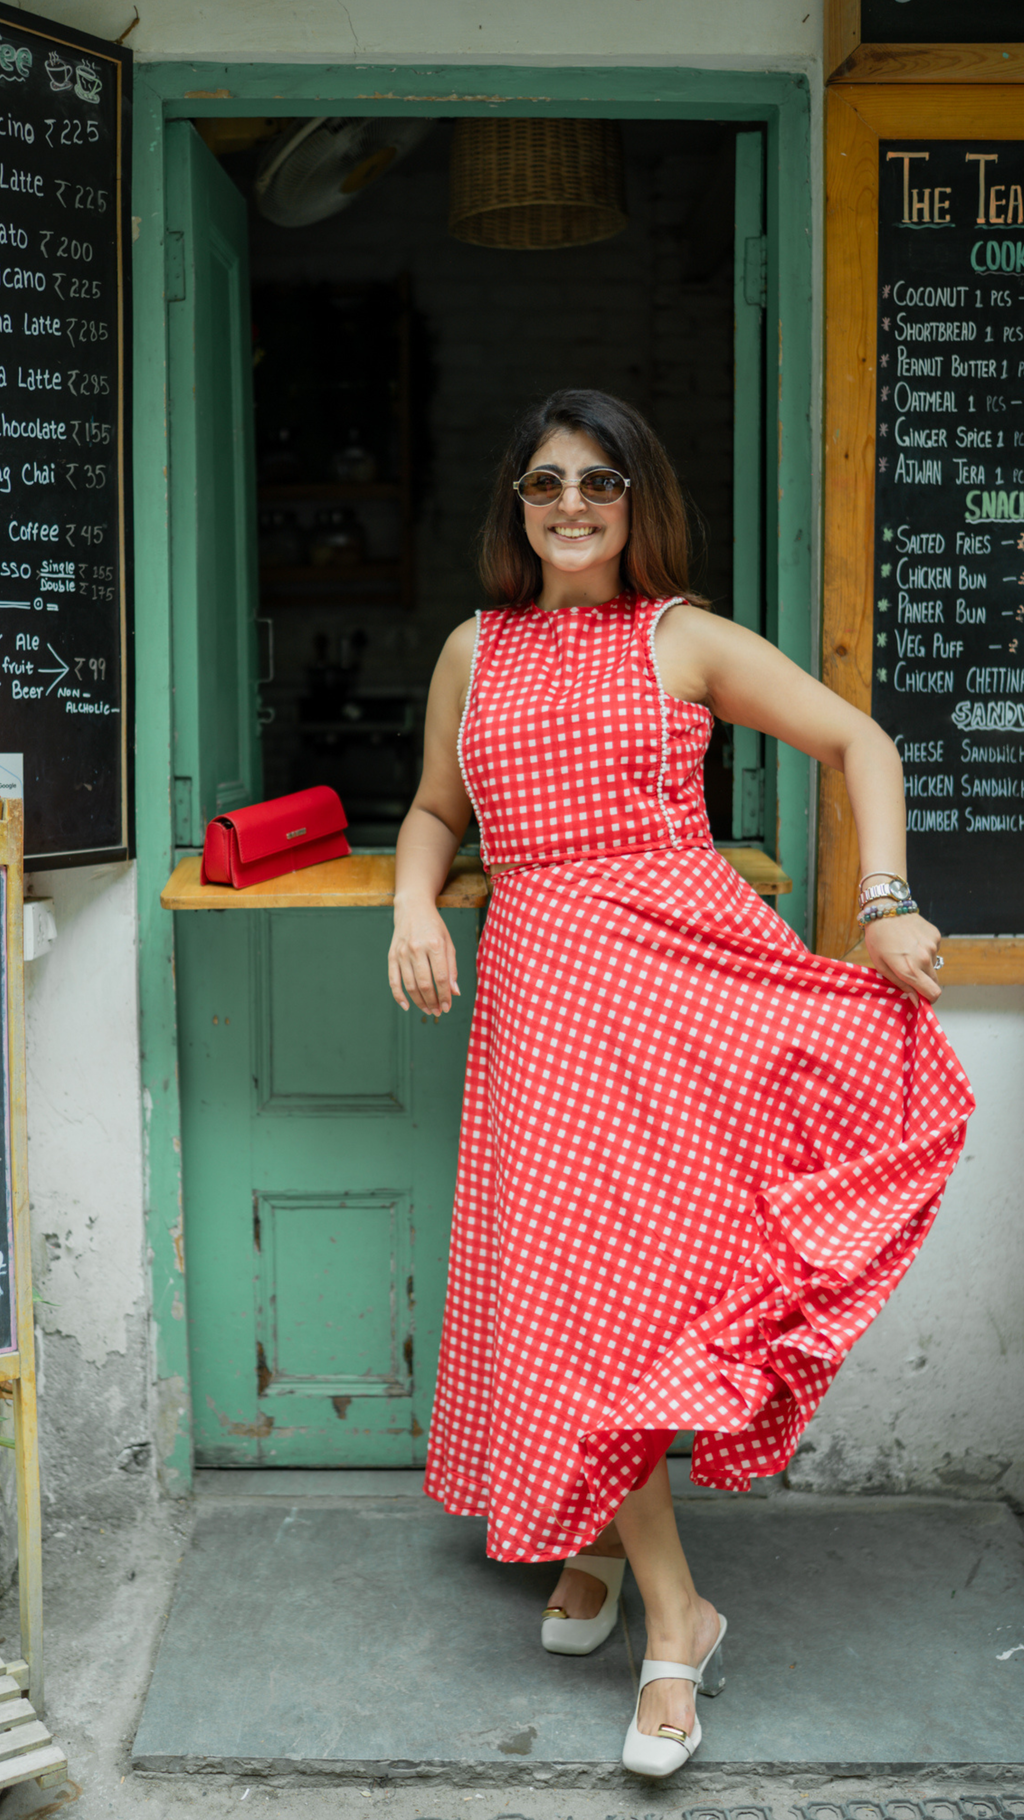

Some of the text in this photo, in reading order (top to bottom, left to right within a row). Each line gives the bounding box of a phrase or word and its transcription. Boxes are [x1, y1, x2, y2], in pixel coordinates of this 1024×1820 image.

[0, 163, 44, 196] Latte
[886, 151, 1024, 224] THE TEA
[893, 280, 1012, 308] COCONUT 1 PCS
[24, 313, 62, 336] Latte
[895, 312, 1024, 343] SHORTBREAD 1 PCS
[897, 345, 944, 377] PEANUT
[951, 354, 997, 378] BUTTER
[1000, 359, 1008, 379] 1
[18, 367, 62, 391] Latte
[894, 381, 1006, 413] OATMEAL 1 PCS
[0, 413, 67, 440] hocolate
[895, 416, 948, 448] GINGER
[955, 426, 992, 448] SPICE
[997, 430, 1005, 448] 1
[21, 462, 55, 485] Chai
[894, 452, 942, 485] AJWAN
[952, 458, 985, 485] JERA
[995, 466, 1004, 485] 1
[9, 520, 59, 542] Coffee
[895, 525, 991, 555] SALTED FRIES
[41, 560, 75, 575] Single
[896, 557, 986, 590] CHICKEN BUN
[40, 577, 76, 593] Double
[897, 591, 986, 624] PANEER BUN
[16, 633, 40, 651] Ale
[894, 628, 963, 658] VEG PUFF
[2, 656, 34, 675] fruit
[894, 661, 954, 693] CHICKEN
[12, 680, 44, 699] Beer
[904, 774, 954, 797] HICKEN
[906, 808, 959, 832] UCUMBER
